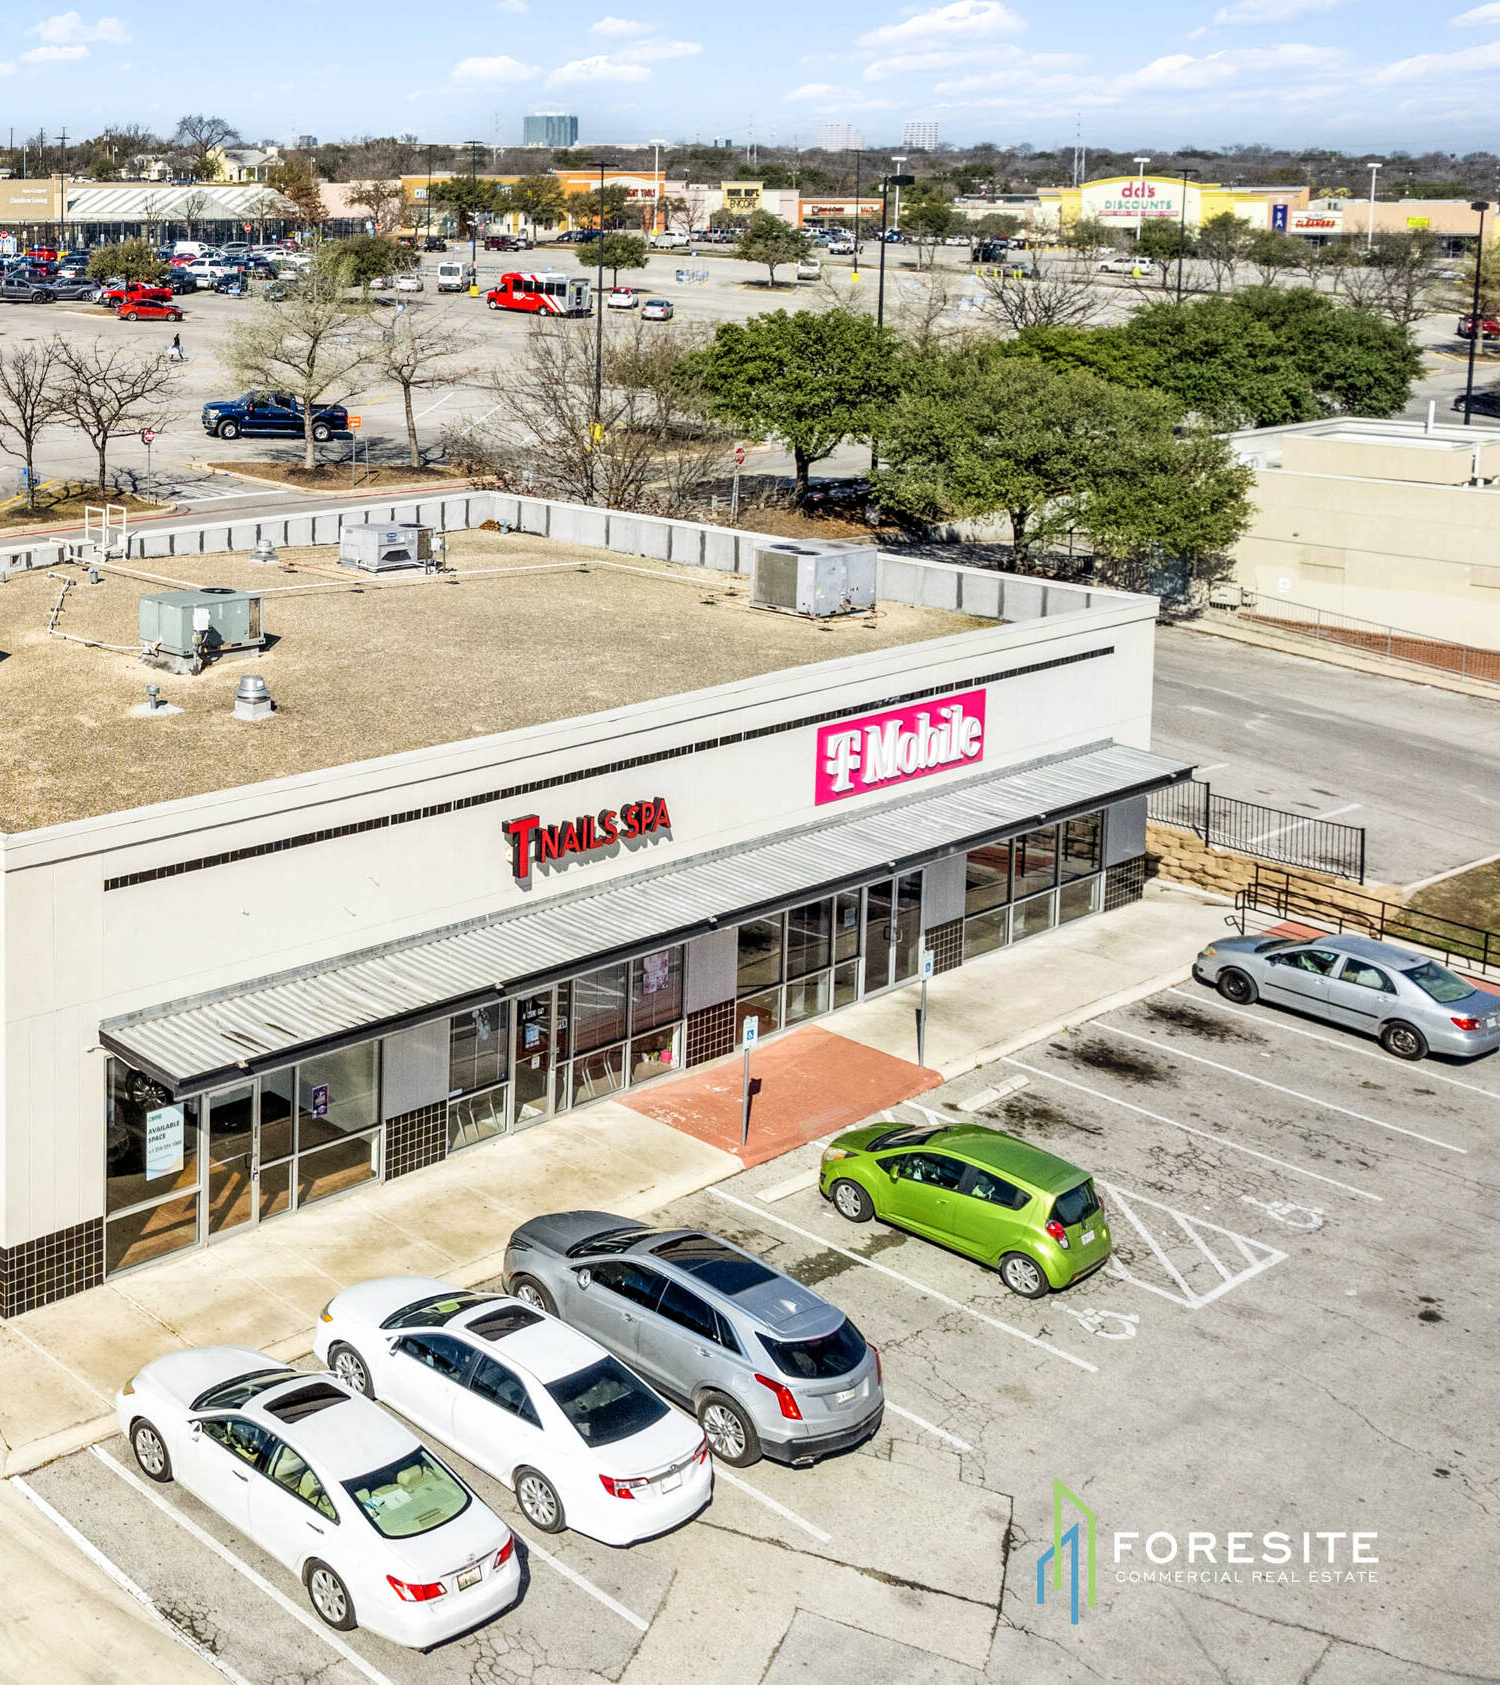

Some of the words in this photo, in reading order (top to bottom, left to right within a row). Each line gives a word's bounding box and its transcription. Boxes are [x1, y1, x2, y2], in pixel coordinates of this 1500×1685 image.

[1104, 200, 1173, 210] DISCOUNTS
[536, 809, 618, 863] NAILS
[620, 797, 672, 839] SPA
[148, 1120, 180, 1135] AVAILABLE
[148, 1133, 166, 1144] SPACE
